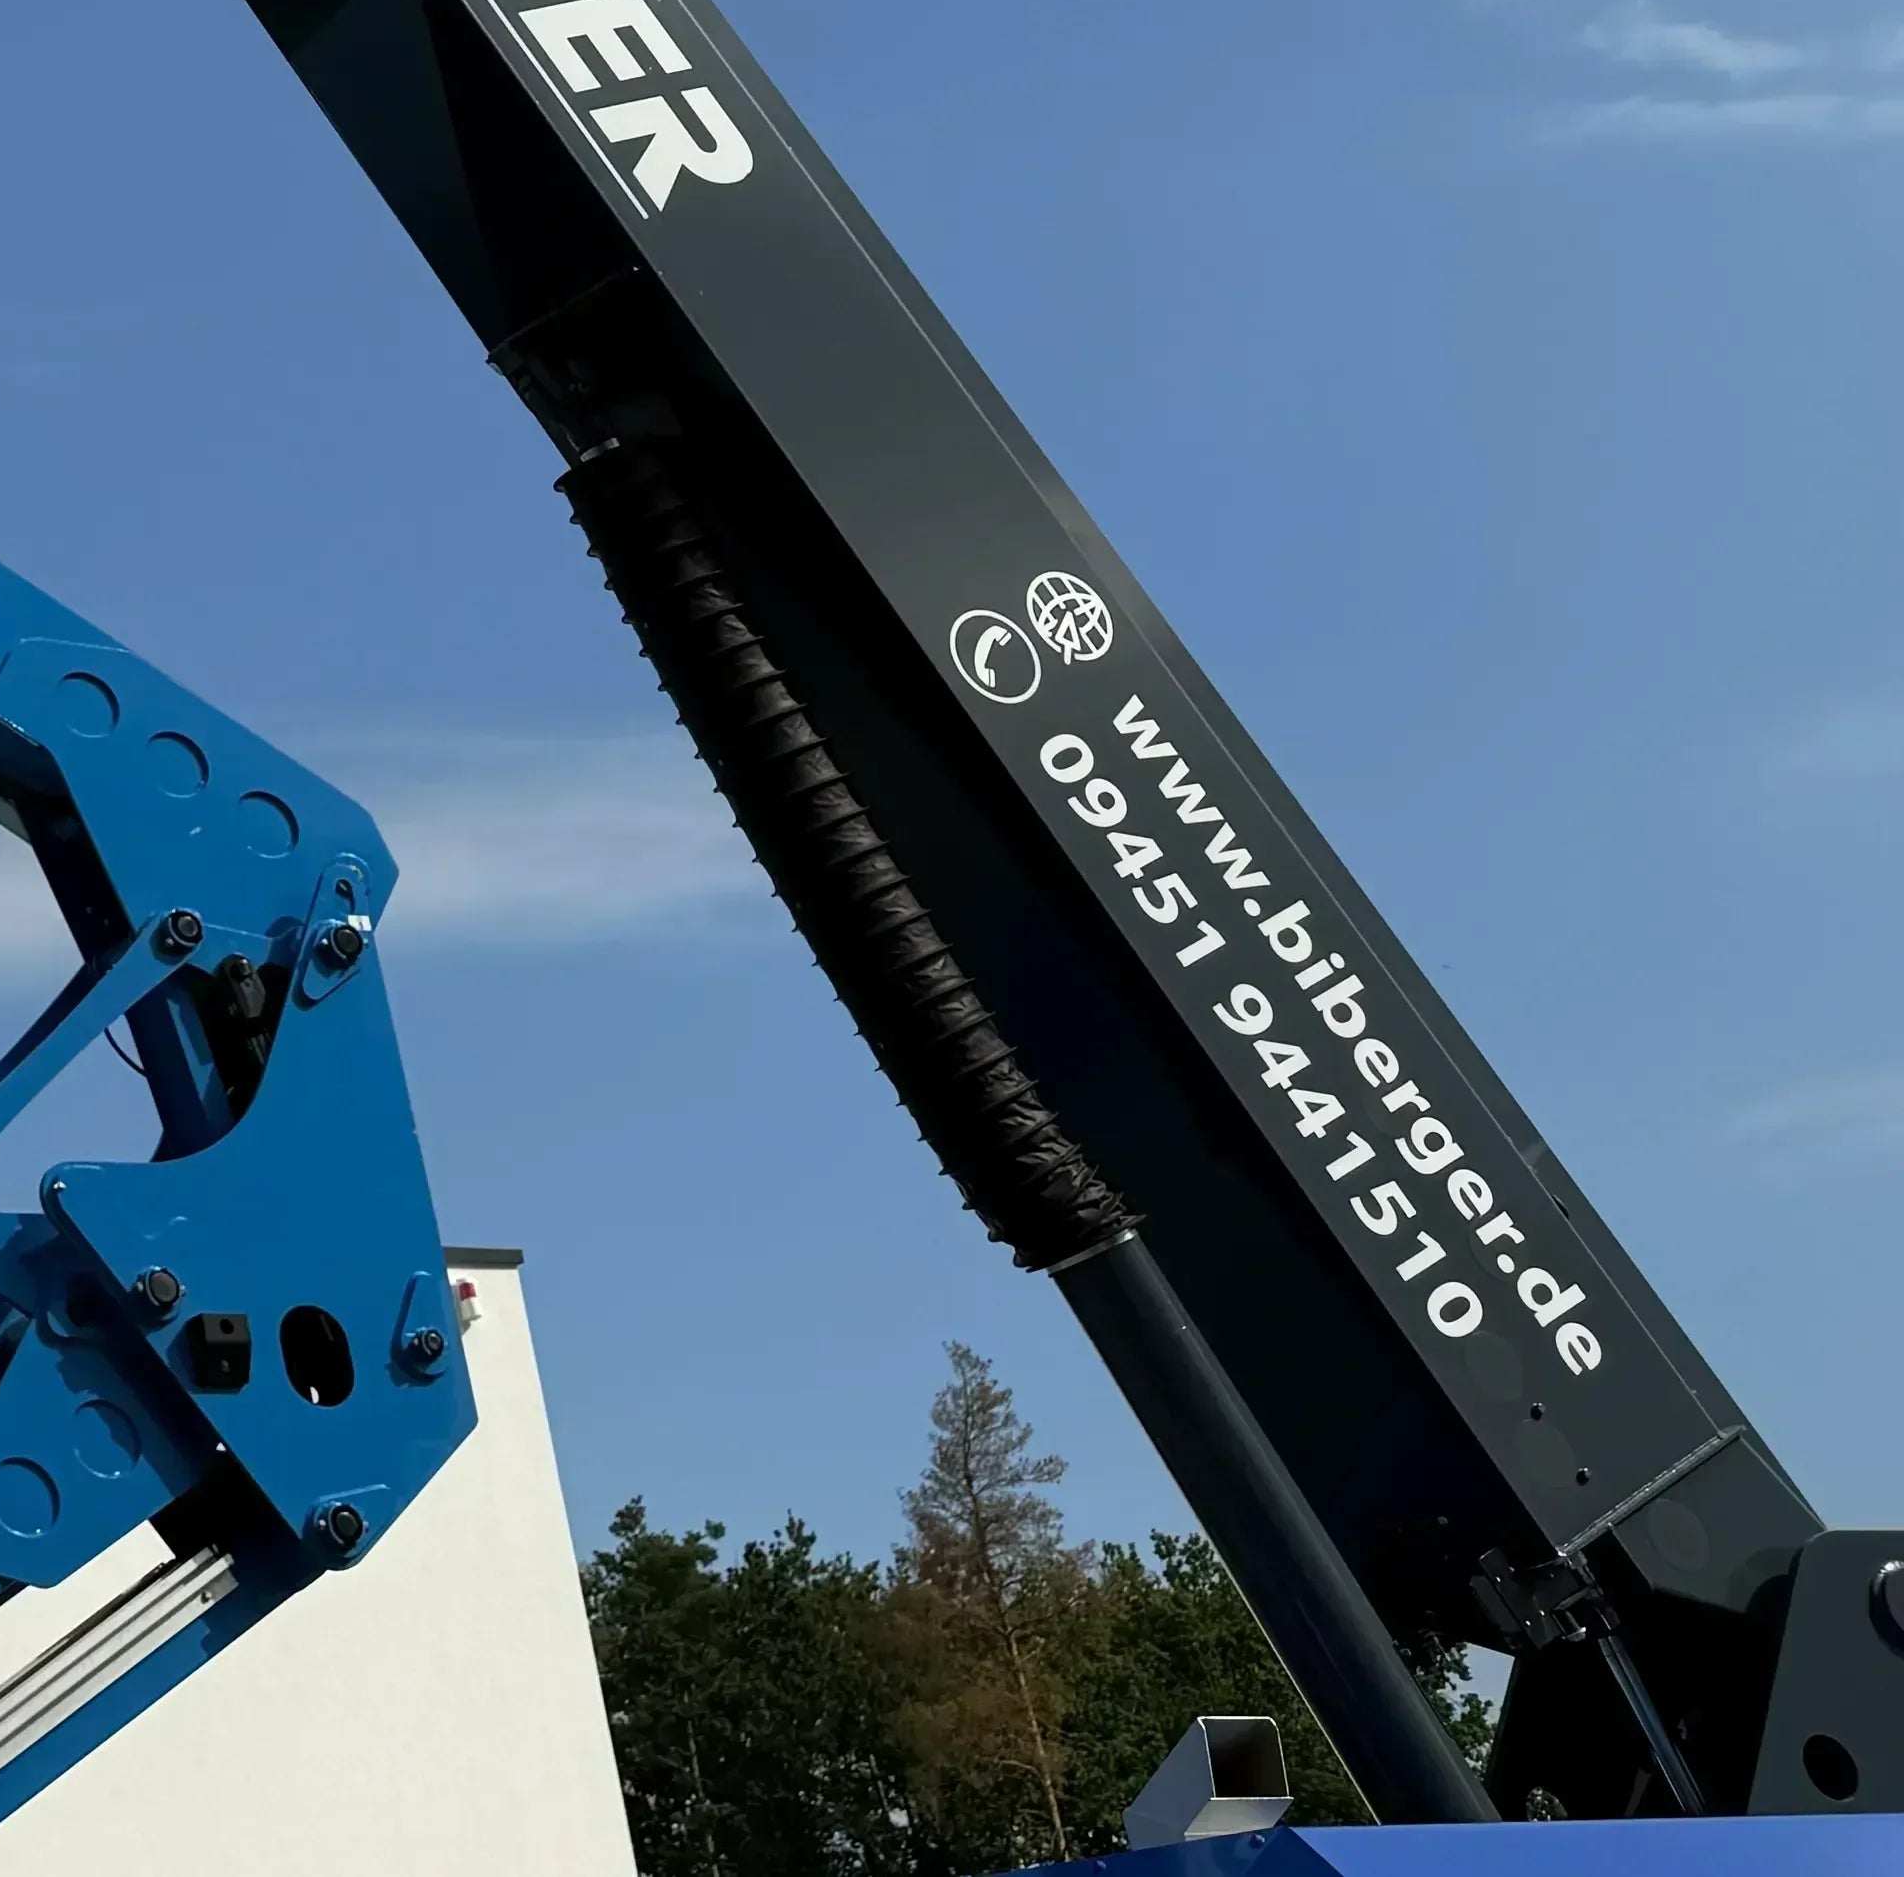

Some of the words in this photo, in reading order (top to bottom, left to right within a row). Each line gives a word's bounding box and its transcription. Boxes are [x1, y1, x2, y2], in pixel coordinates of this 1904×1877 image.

[1039, 733, 1226, 968] 09451
[1212, 983, 1483, 1338] 9441510
[1112, 694, 1602, 1376] www.biberger.de
